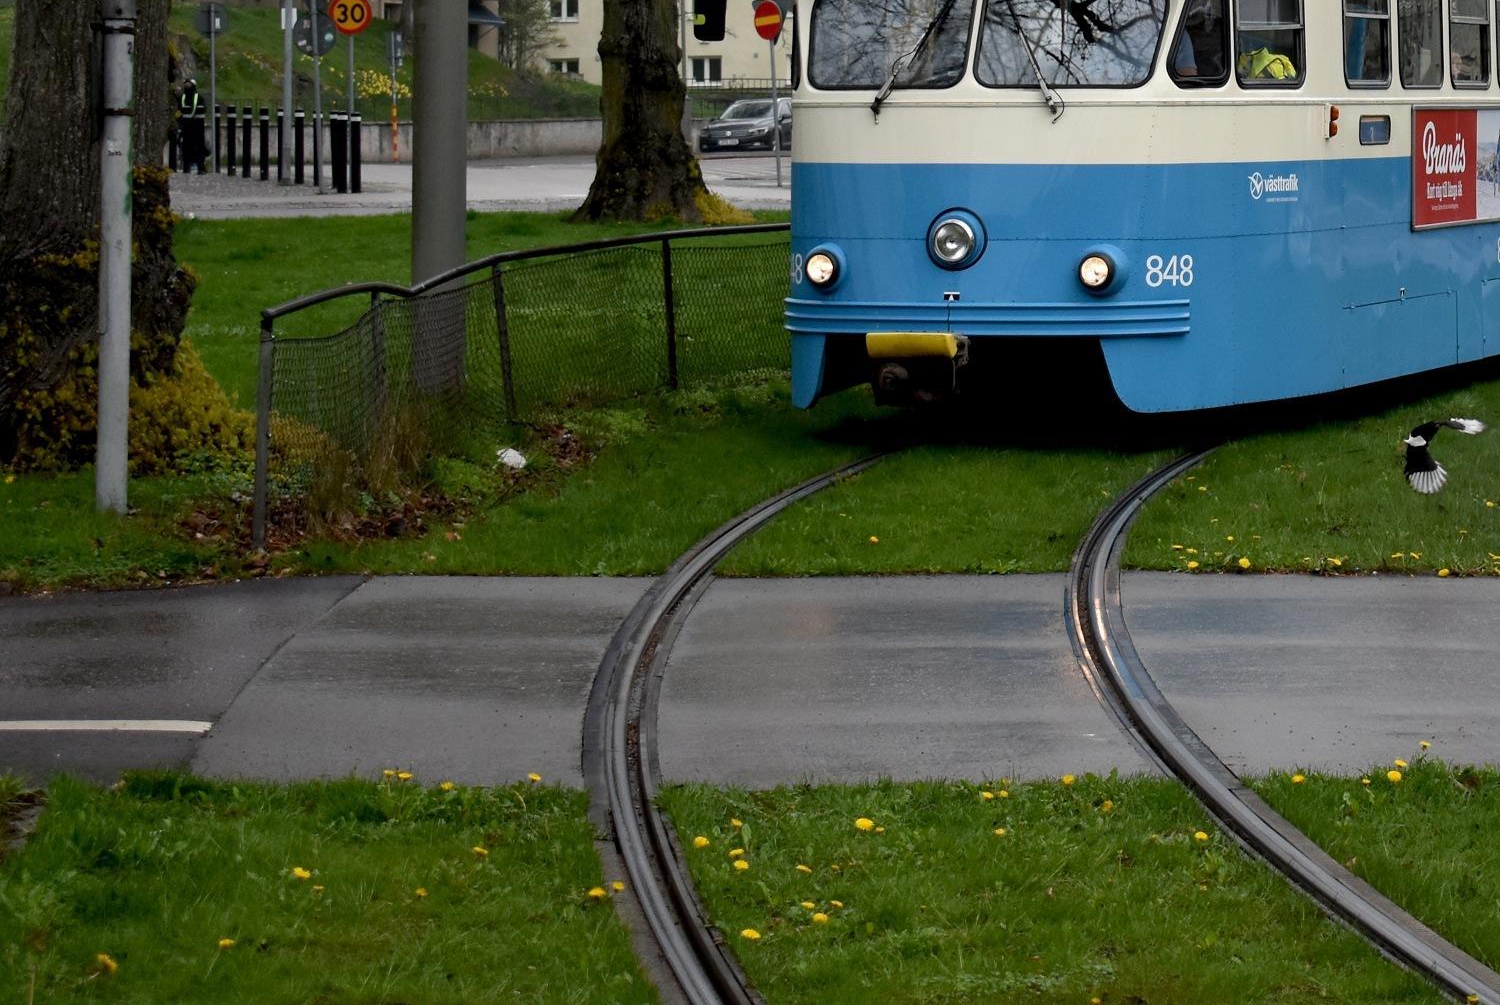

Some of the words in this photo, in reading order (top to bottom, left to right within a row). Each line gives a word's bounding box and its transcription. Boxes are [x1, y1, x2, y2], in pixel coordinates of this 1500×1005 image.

[336, 3, 365, 24] 30
[1422, 121, 1466, 175] Branäs
[1264, 174, 1299, 192] västtrafik
[1145, 254, 1194, 288] 848
